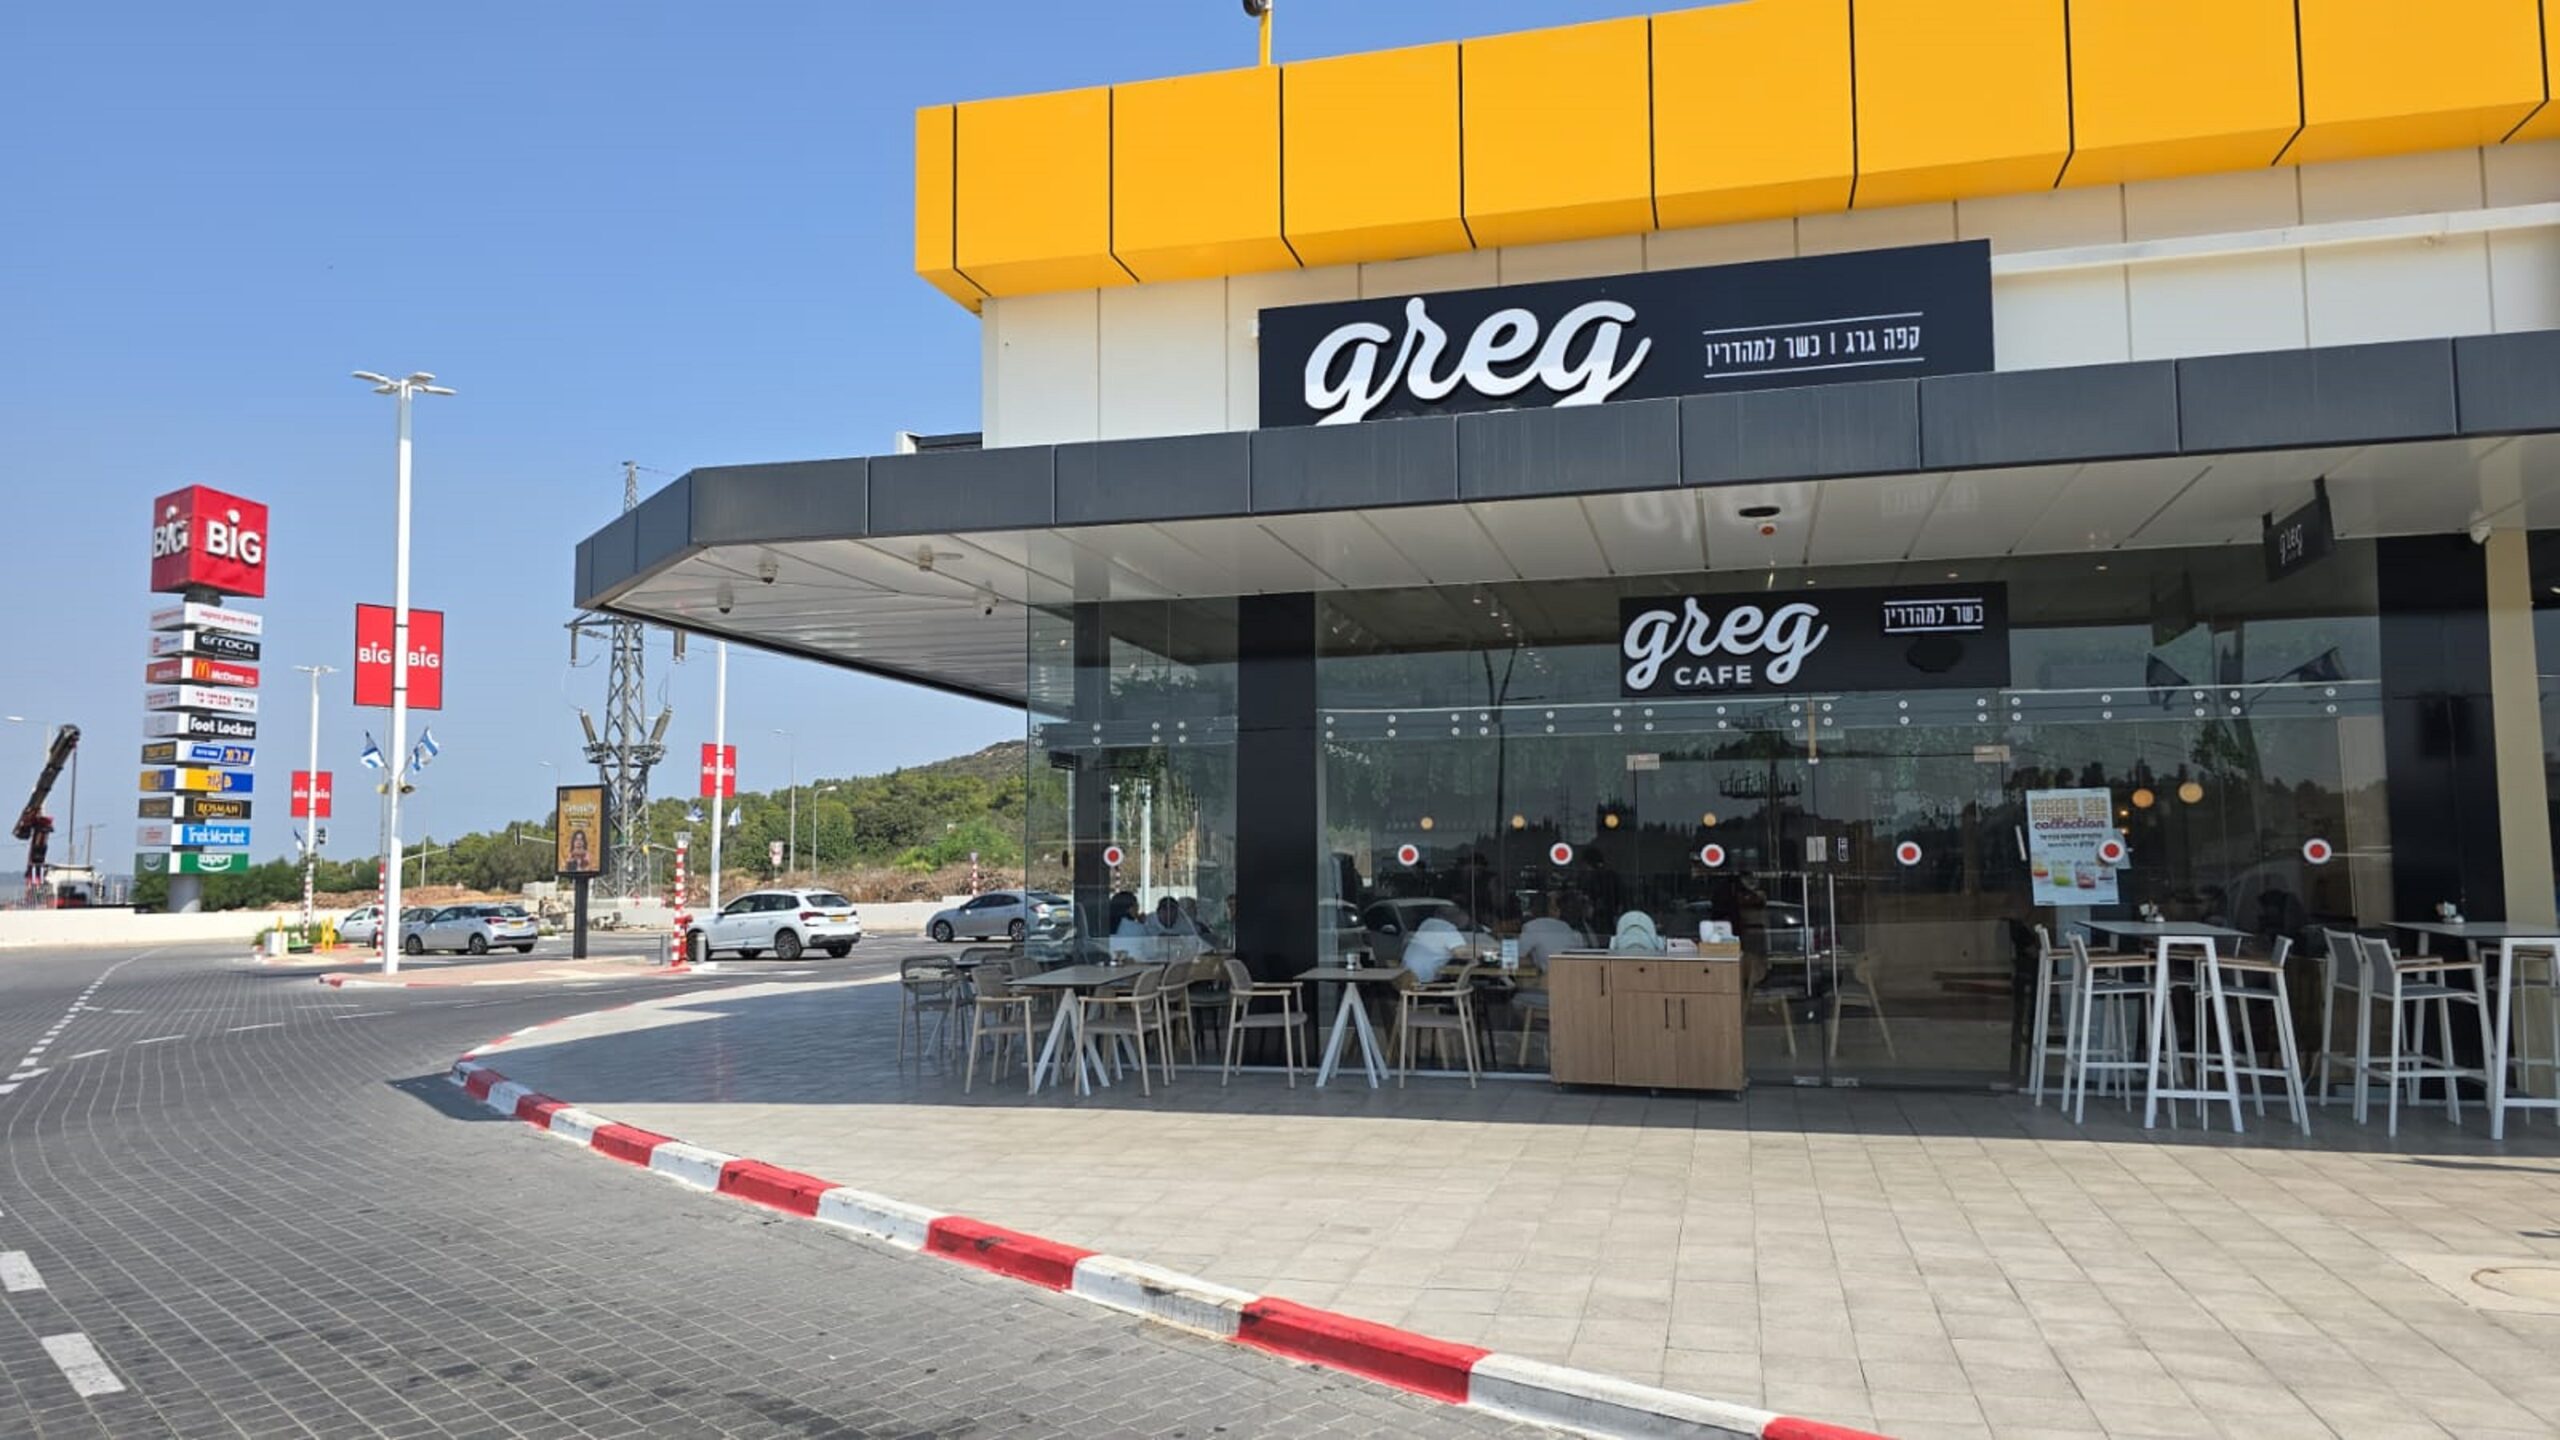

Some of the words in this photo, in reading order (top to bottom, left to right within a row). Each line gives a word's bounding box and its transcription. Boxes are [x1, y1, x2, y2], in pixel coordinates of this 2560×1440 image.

[1783, 334, 1821, 360] כשר
[1844, 329, 1877, 355] גרג
[1883, 325, 1921, 351] קפה
[1304, 296, 1652, 427] greg
[1705, 337, 1776, 368] למהדרין
[1883, 604, 1945, 628] למהדרין
[1951, 604, 1984, 624] כשר
[1623, 597, 1830, 690] greg
[1674, 665, 1753, 687] CAFE
[190, 716, 215, 733] Foot
[217, 720, 254, 737] Locker
